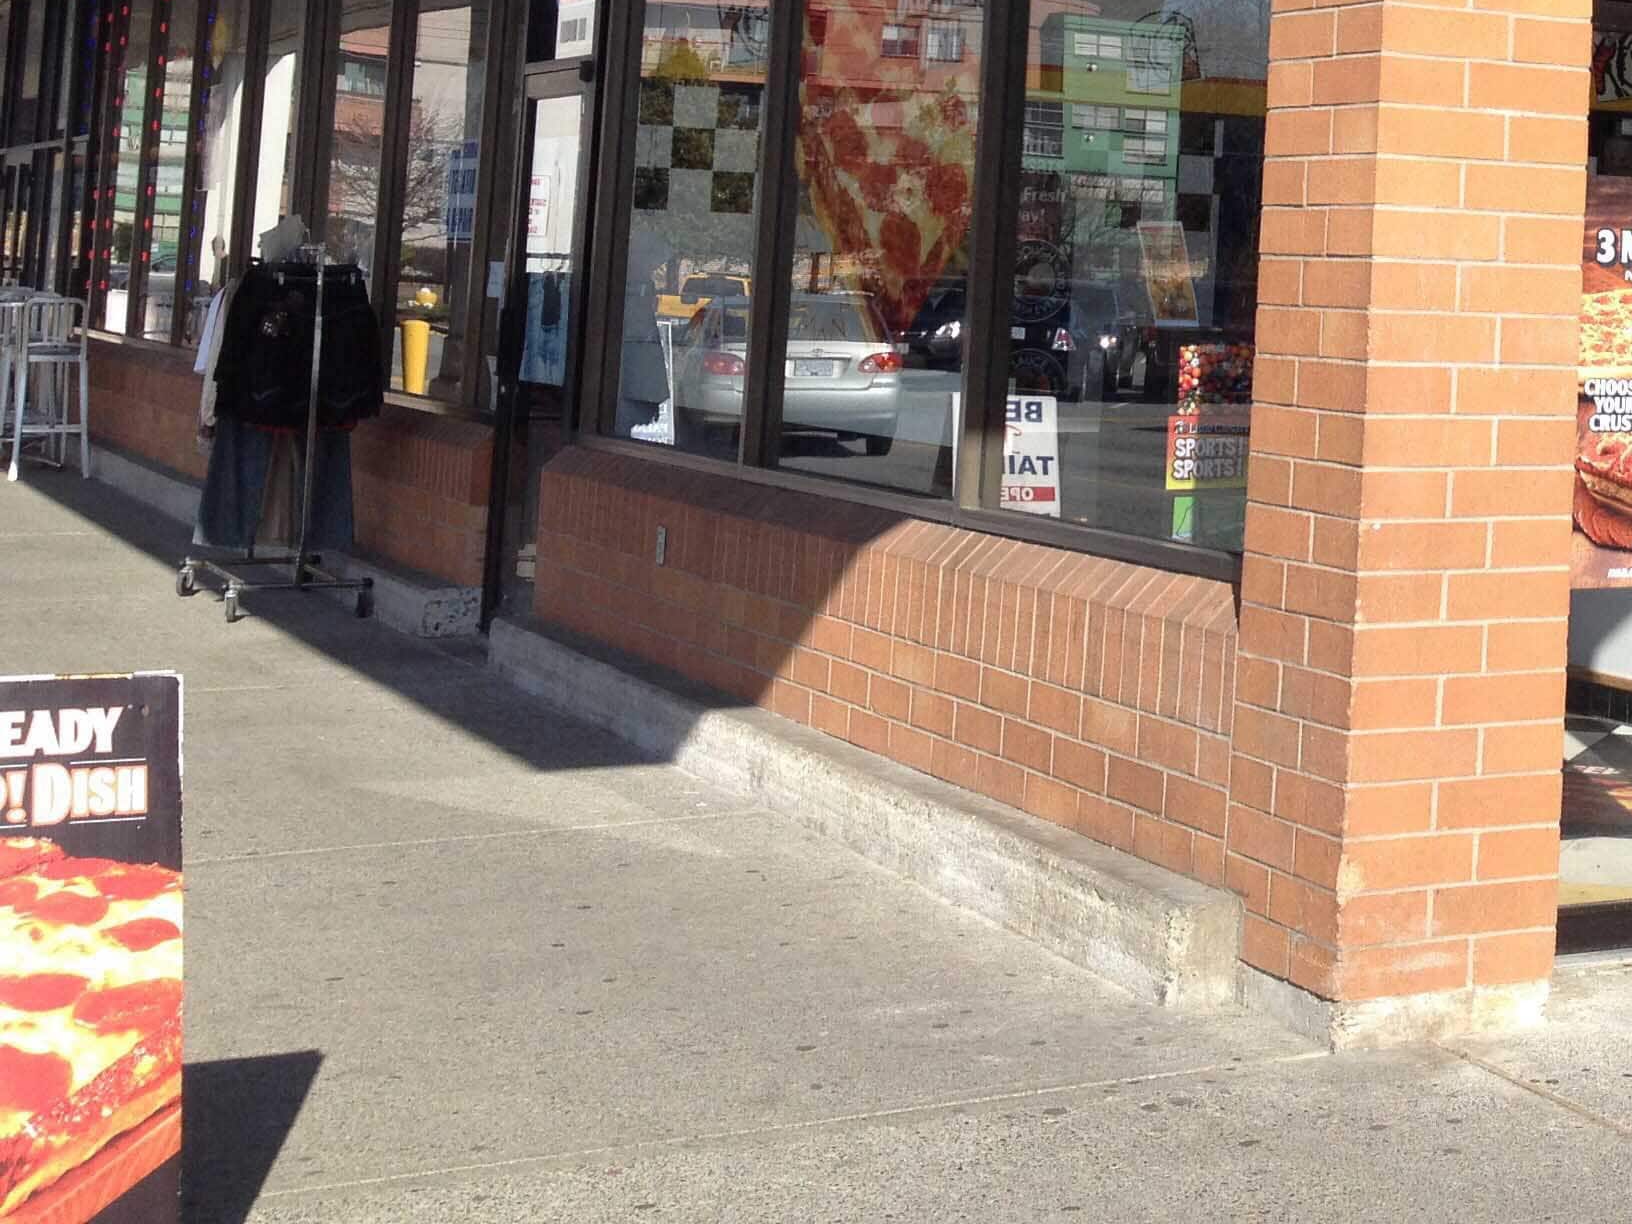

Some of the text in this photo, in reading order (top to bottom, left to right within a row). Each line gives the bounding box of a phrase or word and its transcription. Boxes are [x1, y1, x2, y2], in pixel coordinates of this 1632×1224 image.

[1018, 207, 1046, 229] ay!
[1596, 229, 1616, 263] 3
[0, 705, 125, 759] EADY
[31, 763, 149, 828] DISH
